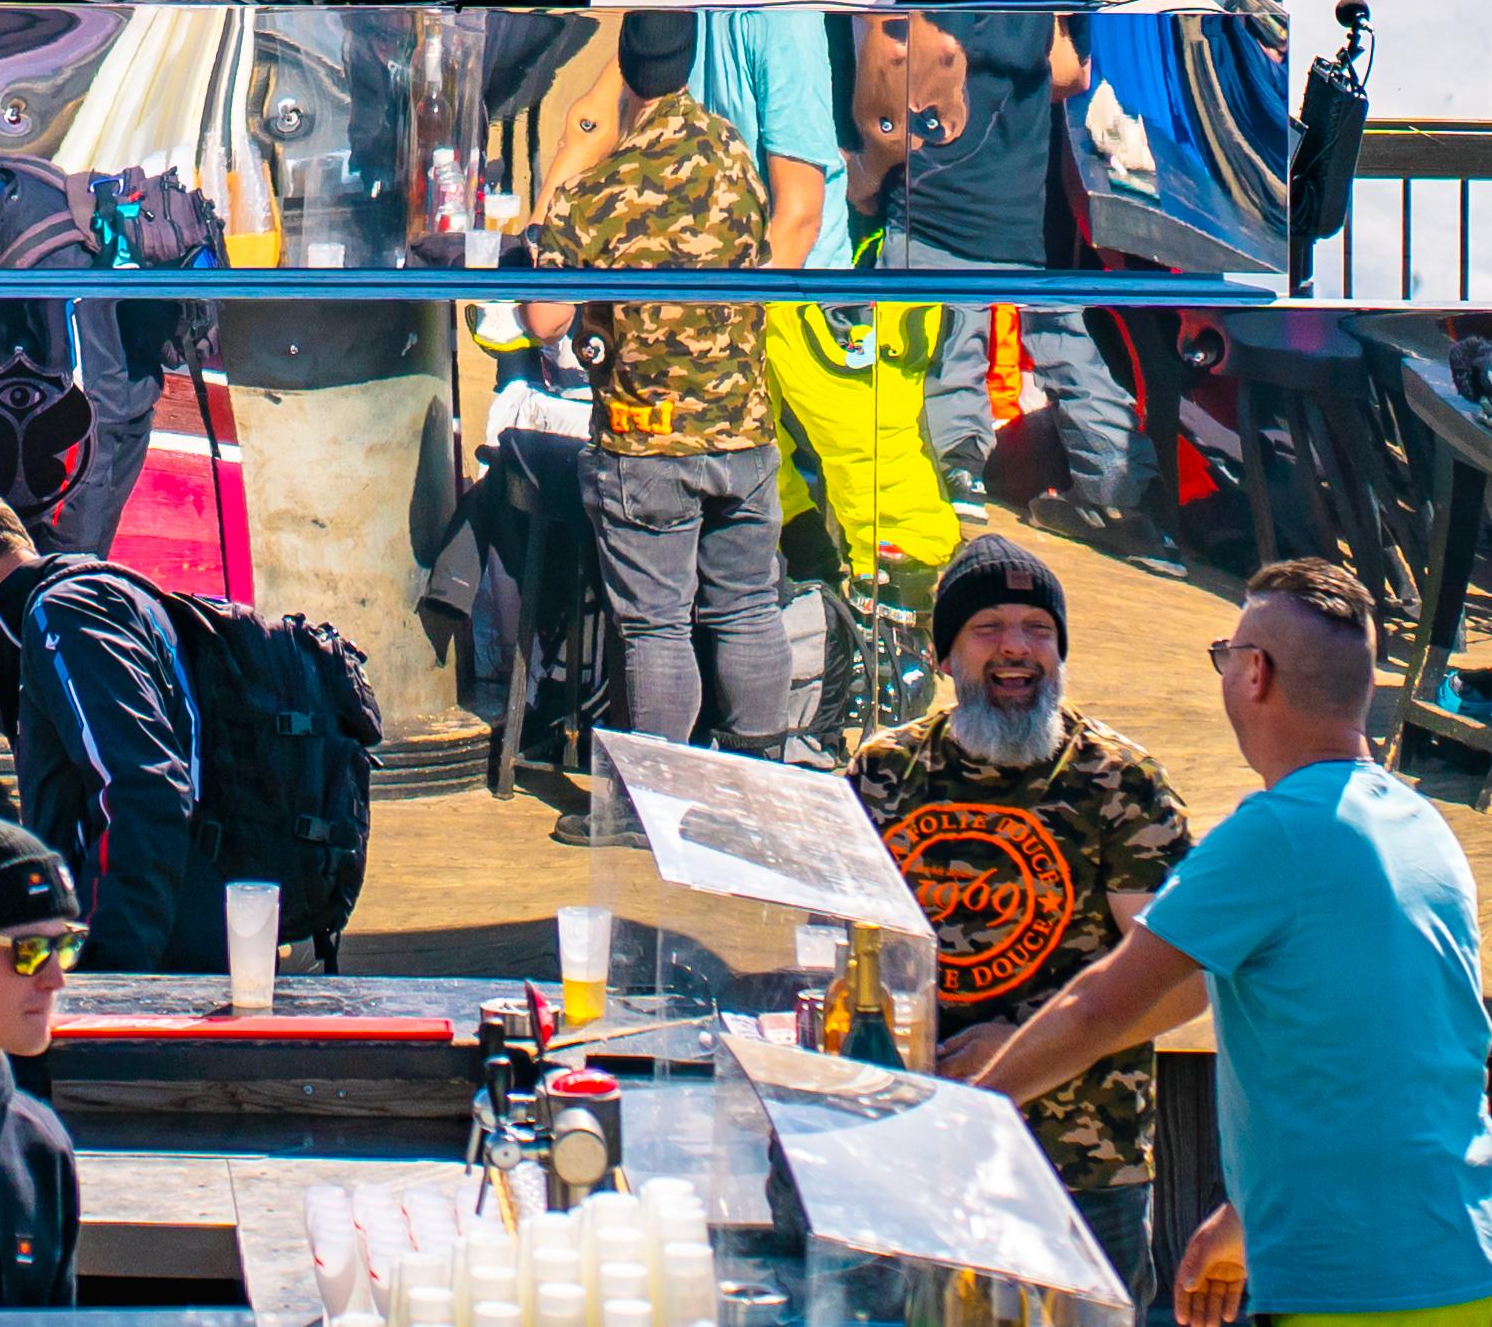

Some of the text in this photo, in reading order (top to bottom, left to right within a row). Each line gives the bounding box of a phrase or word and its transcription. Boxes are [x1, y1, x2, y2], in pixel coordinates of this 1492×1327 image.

[906, 814, 988, 844] FOLIE
[917, 867, 1022, 929] 1969
[972, 917, 1056, 988] DOUCE
